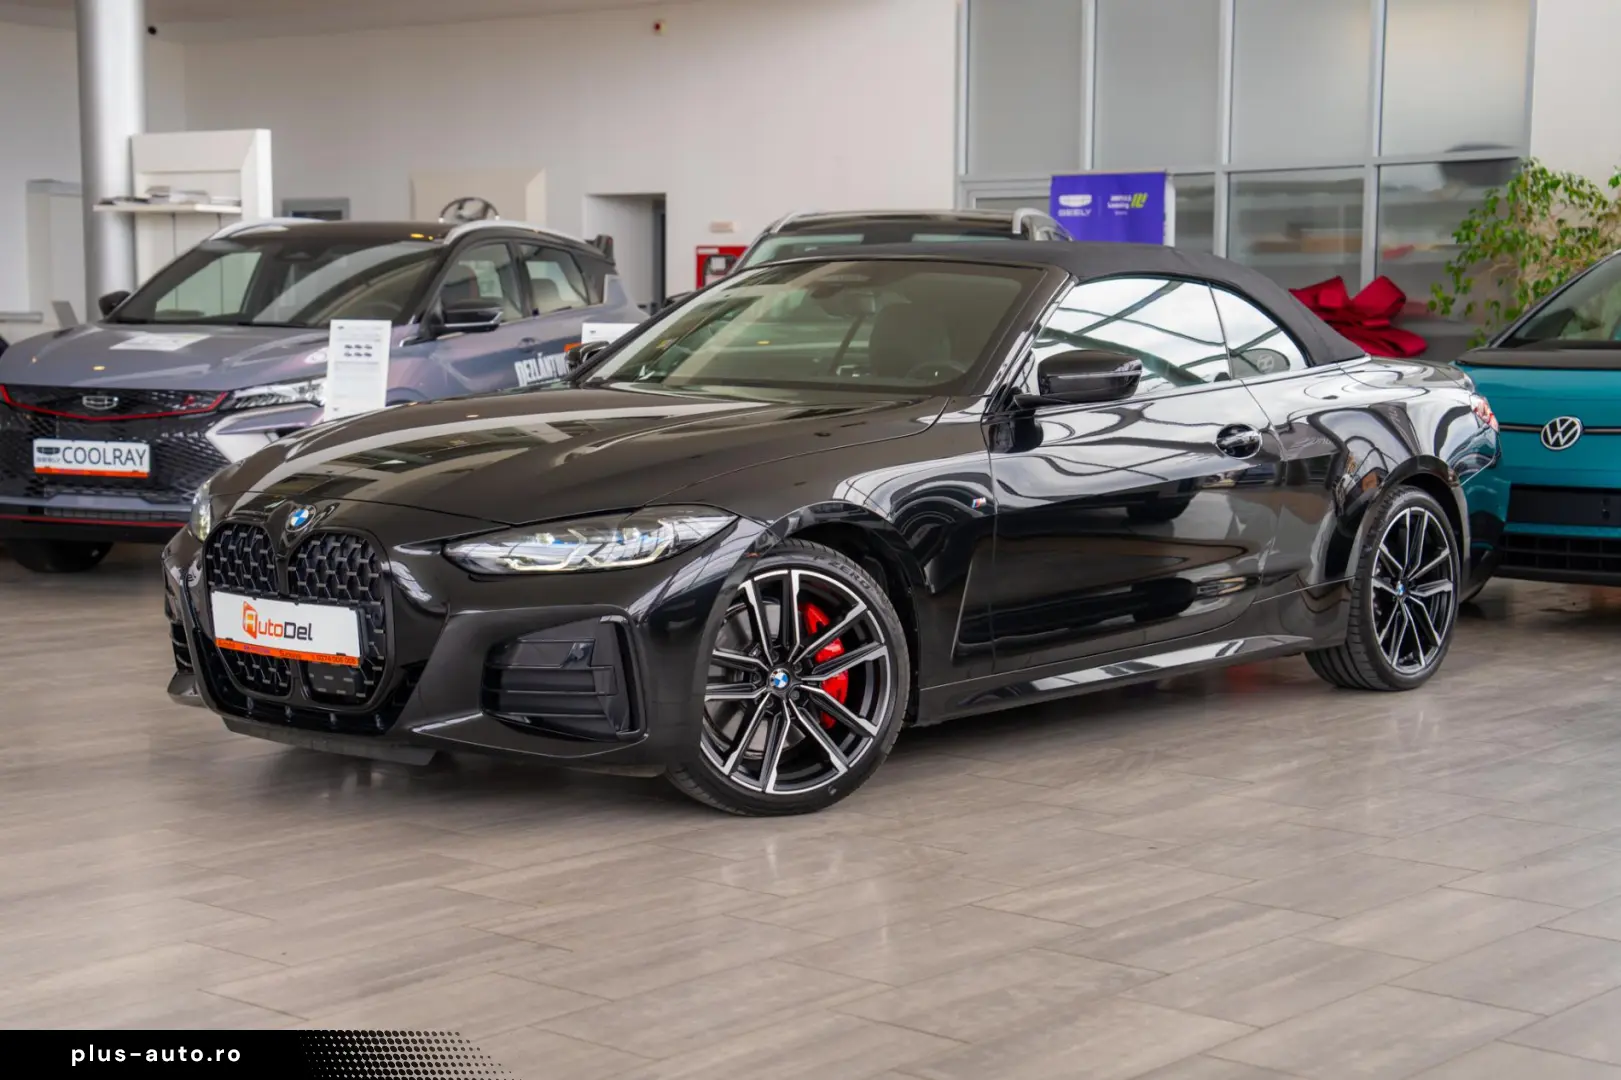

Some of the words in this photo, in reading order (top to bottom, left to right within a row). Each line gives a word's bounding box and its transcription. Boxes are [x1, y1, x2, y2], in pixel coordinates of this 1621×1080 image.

[62, 446, 146, 466] COOLRAY
[828, 561, 871, 590] ZERO
[242, 600, 313, 641] AutoDel
